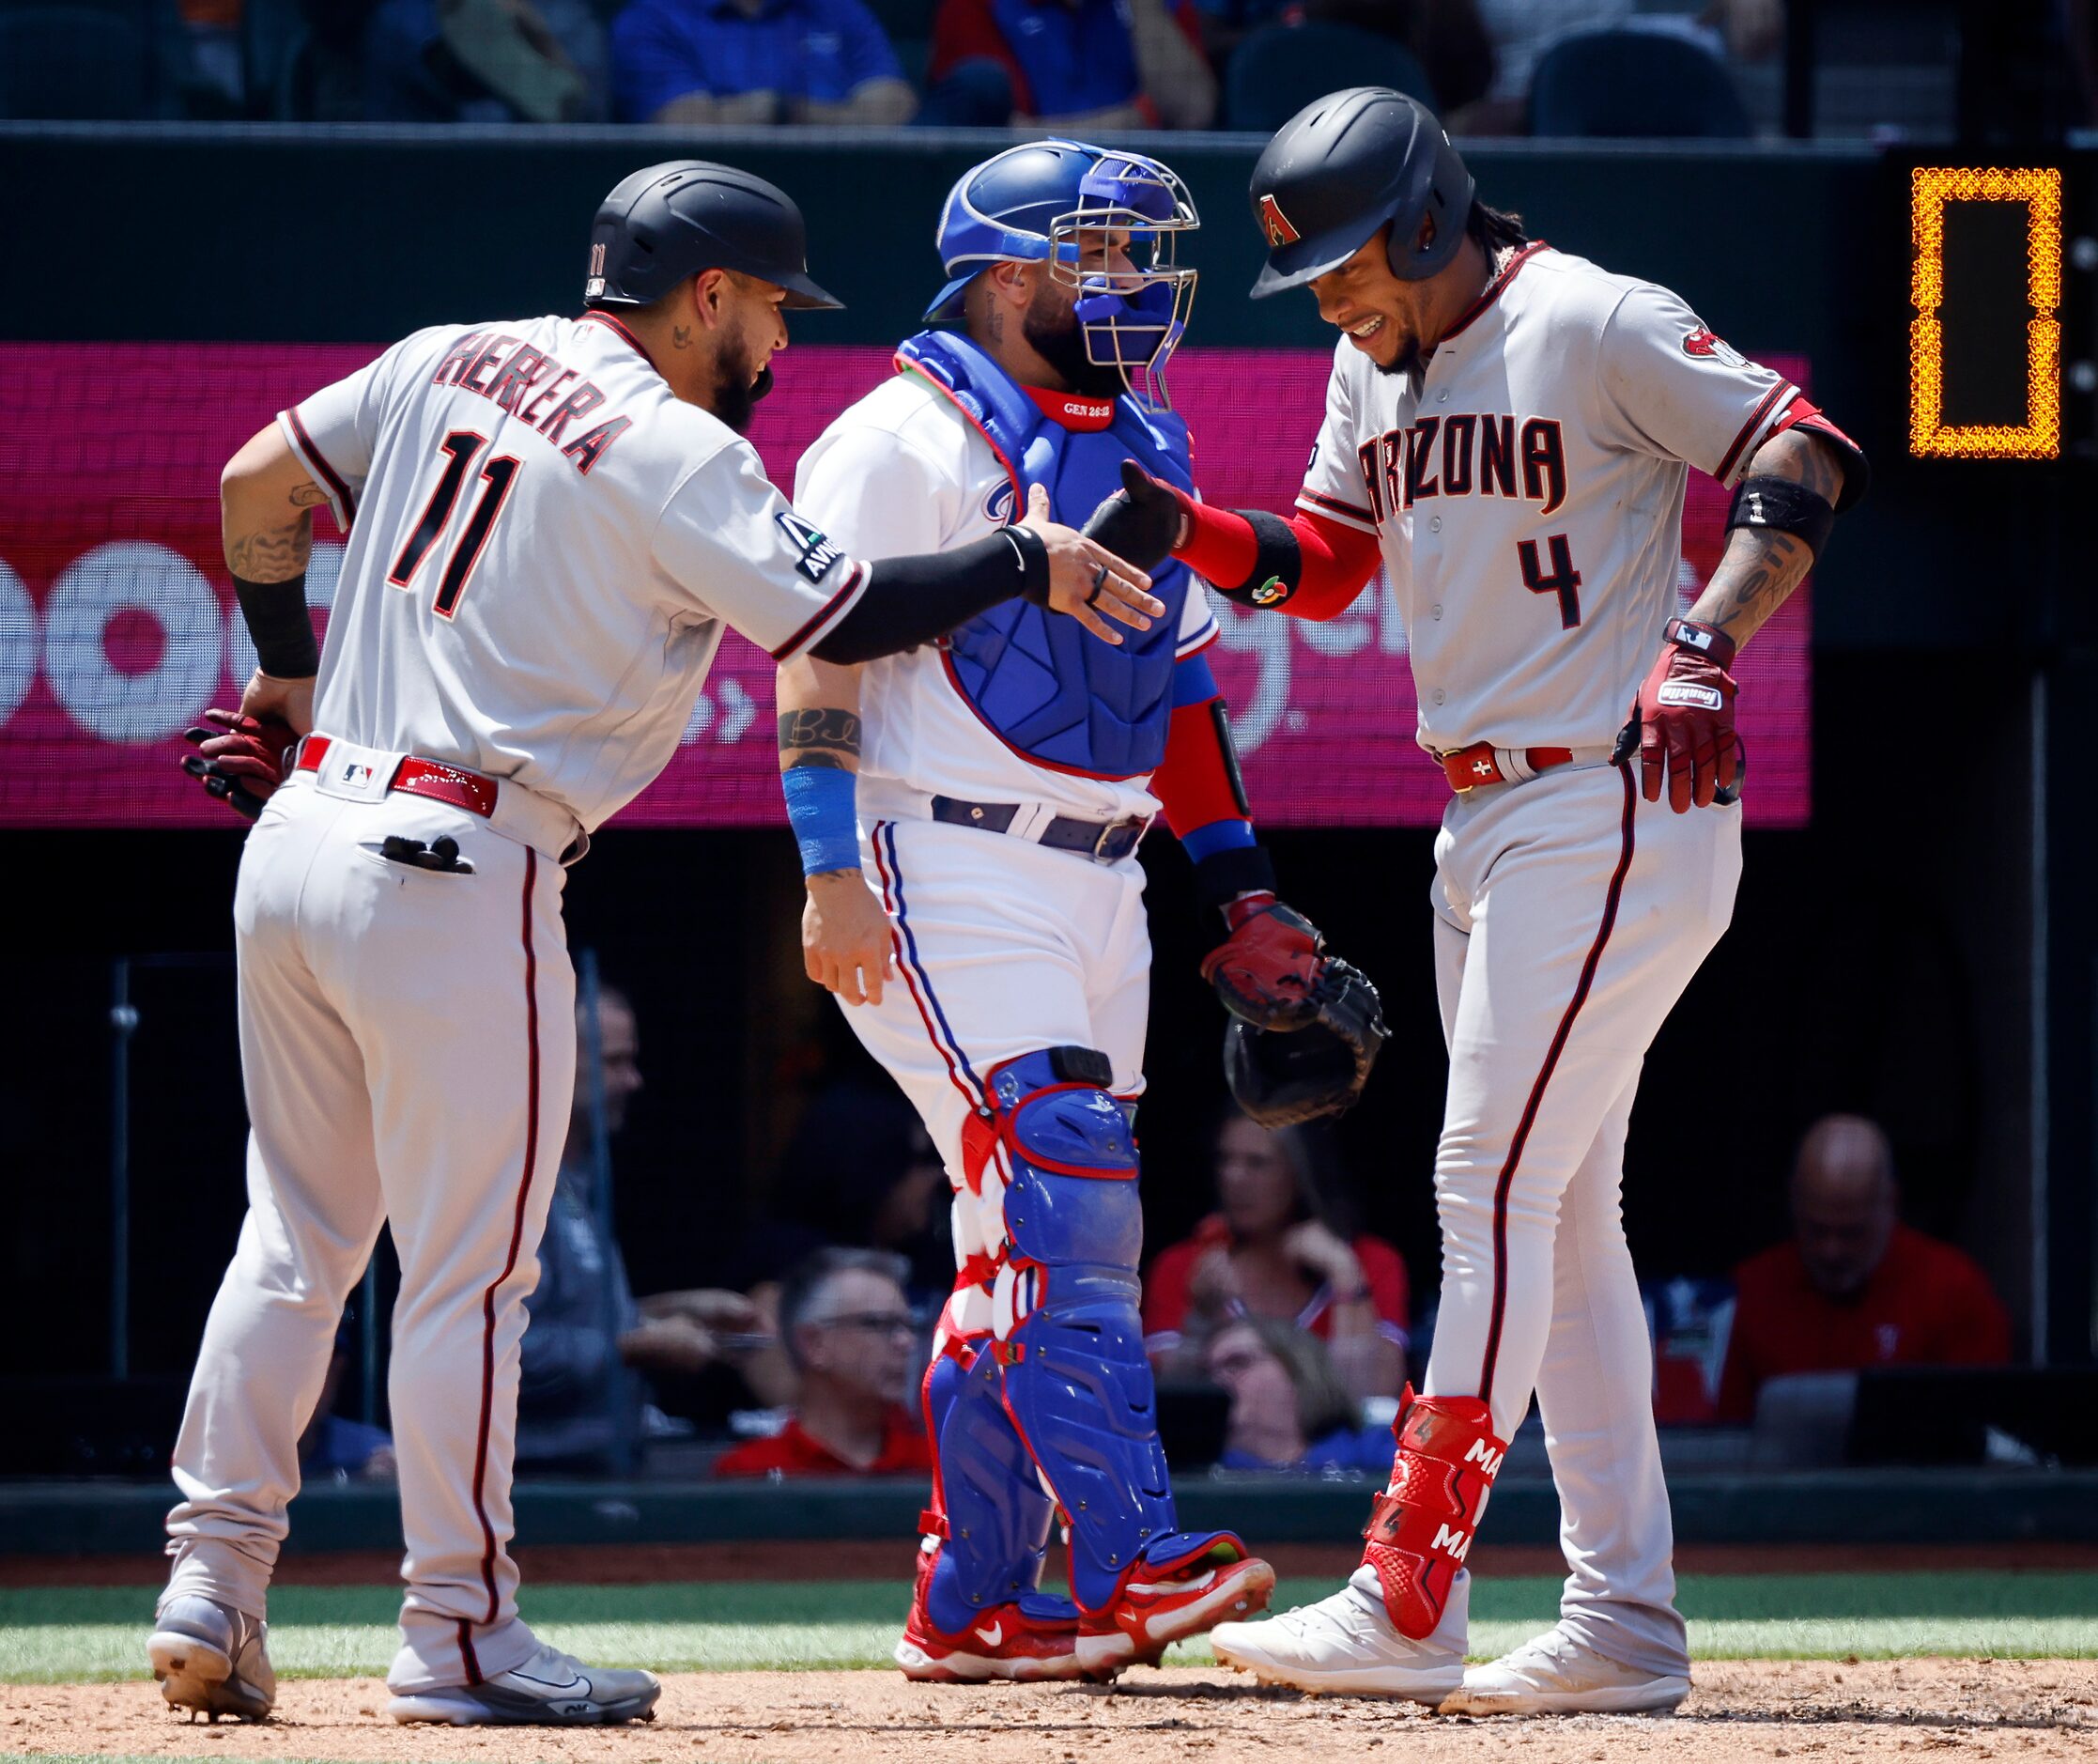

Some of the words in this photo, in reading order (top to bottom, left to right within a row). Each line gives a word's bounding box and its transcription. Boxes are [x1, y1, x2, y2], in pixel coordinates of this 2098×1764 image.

[590, 243, 606, 276] 11
[1910, 166, 2061, 459] 0
[433, 334, 634, 476] HERRERA
[1064, 402, 1088, 416] GEN
[386, 428, 524, 622] 11
[1517, 534, 1582, 630] 4
